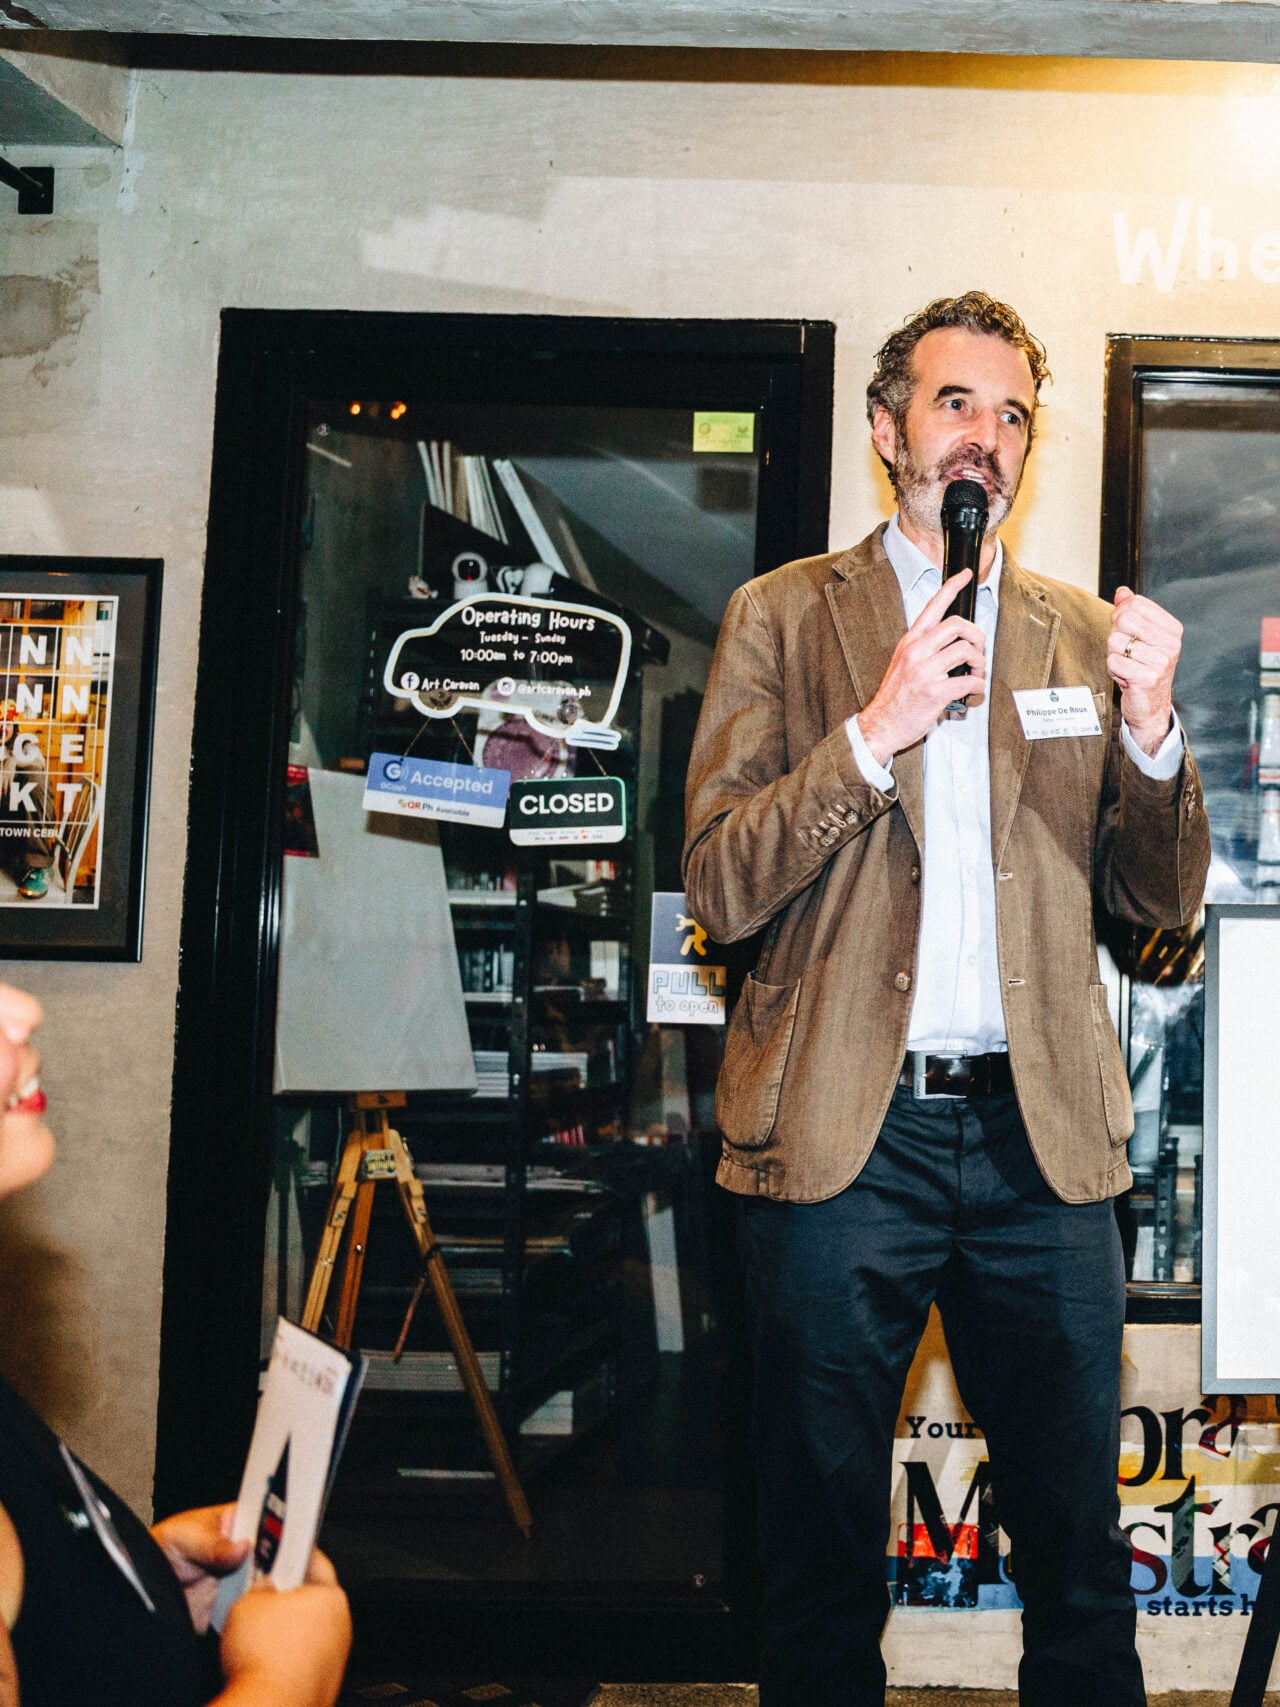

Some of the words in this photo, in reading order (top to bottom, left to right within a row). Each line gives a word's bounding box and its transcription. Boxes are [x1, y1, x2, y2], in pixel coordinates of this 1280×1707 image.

[461, 606, 541, 628] Operating
[549, 611, 596, 631] Hours
[480, 631, 519, 644] Tuesday
[534, 633, 566, 645] Sunday
[460, 649, 506, 661] 10:00am
[513, 649, 525, 661] to
[530, 651, 573, 666] 7:00pm
[421, 678, 440, 691] Art
[442, 678, 480, 691] Caravan
[518, 682, 592, 699] @artcaravan.ph
[1026, 708, 1057, 717] Philippe
[410, 770, 494, 795] Accepted
[407, 801, 422, 810] QR
[422, 802, 434, 811] Ph
[436, 806, 470, 817] Available
[519, 792, 614, 815] CLOSED
[652, 970, 725, 997] PULL
[655, 995, 674, 1012] to
[680, 999, 720, 1017] open
[905, 1416, 980, 1439] Your
[1146, 1595, 1233, 1617] starts
